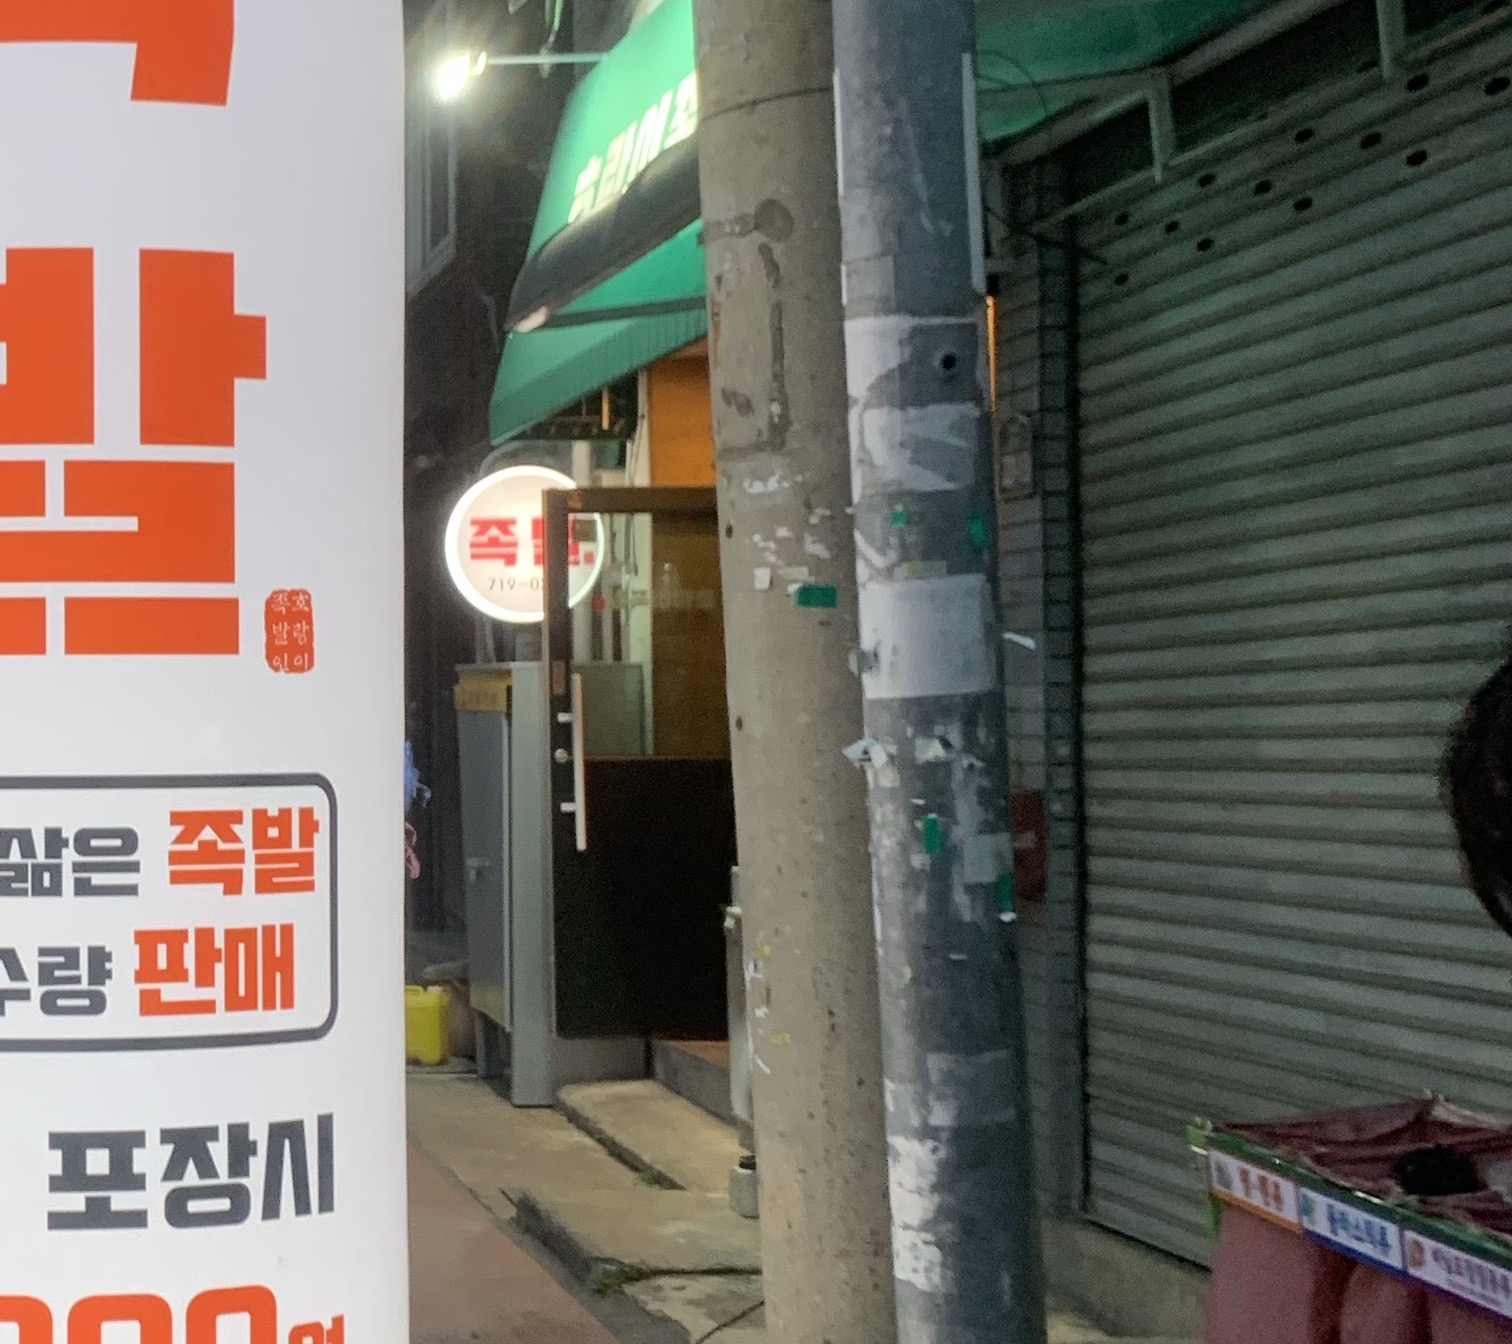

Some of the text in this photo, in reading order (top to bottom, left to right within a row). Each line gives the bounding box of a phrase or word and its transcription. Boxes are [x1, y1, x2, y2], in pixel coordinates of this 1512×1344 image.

[168, 806, 320, 896] 족발
[134, 922, 295, 1017] 판매
[47, 1111, 335, 1231] 포장시
